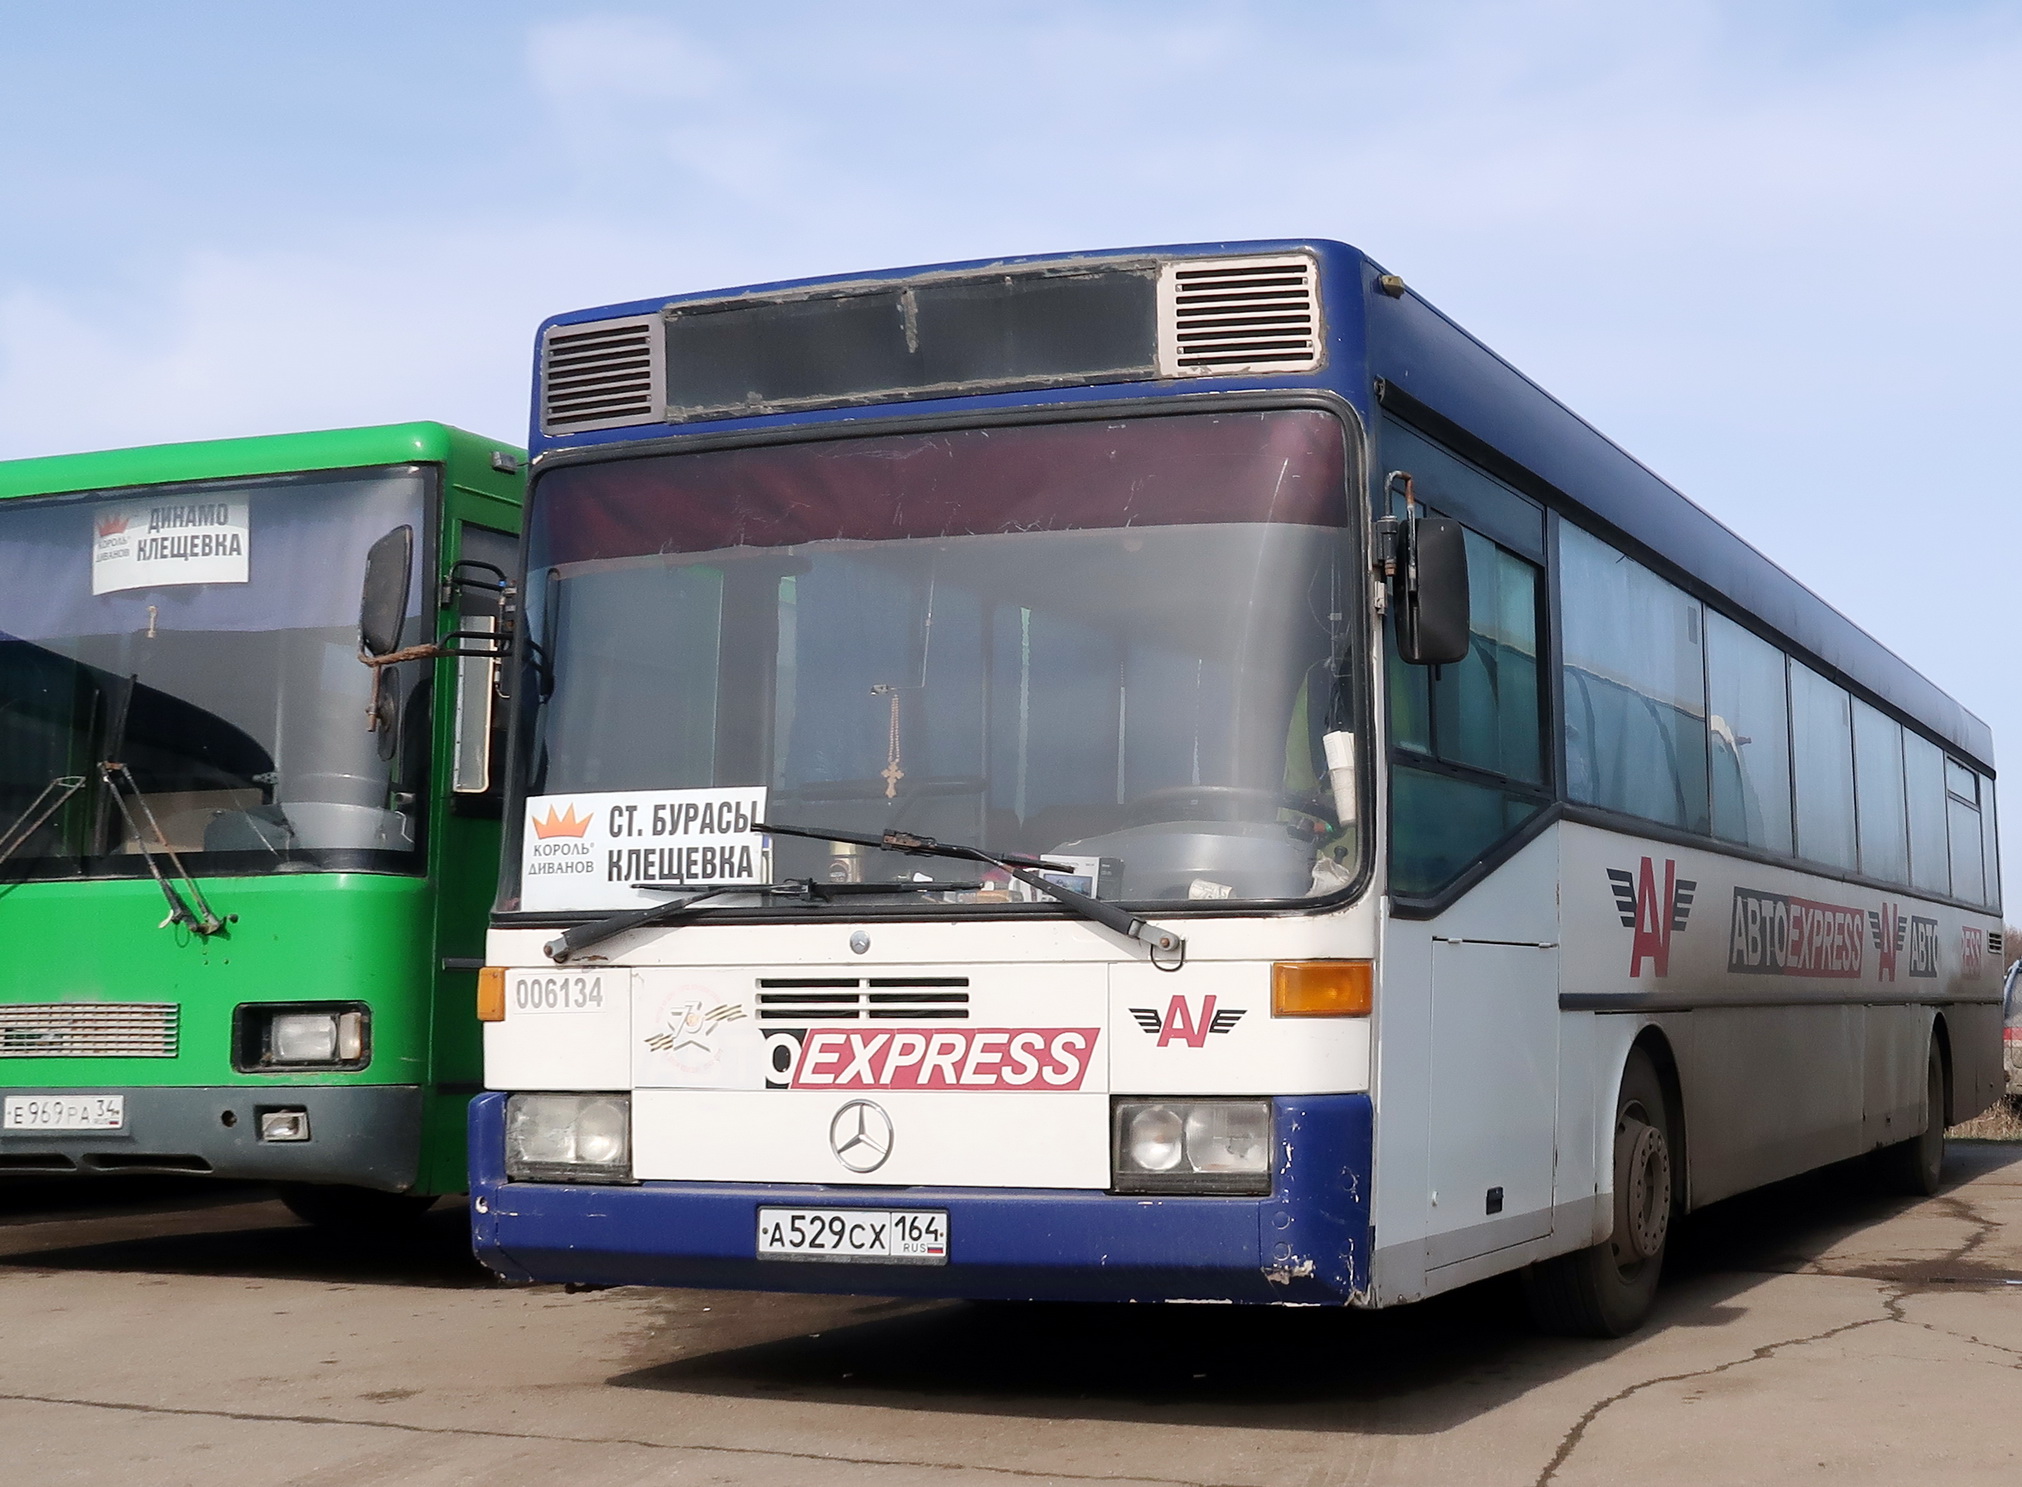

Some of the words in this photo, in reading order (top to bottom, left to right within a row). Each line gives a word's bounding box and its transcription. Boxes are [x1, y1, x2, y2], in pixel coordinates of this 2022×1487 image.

[148, 503, 229, 534] ДИНАМО
[136, 534, 242, 562] КЛЕЩЕВКА
[609, 805, 643, 838] СТ.
[652, 800, 758, 837] БУРАСЫ
[533, 843, 591, 857] КОРОЛЬ
[607, 845, 754, 884] КЛЕЩЕВКА
[528, 860, 595, 876] ДИВАНОВ
[516, 976, 604, 1010] 006134
[14, 1101, 91, 1125] Е969РА
[769, 1215, 887, 1250] А529СХ
[894, 1215, 939, 1242] 164
[903, 1243, 927, 1254] RUS
